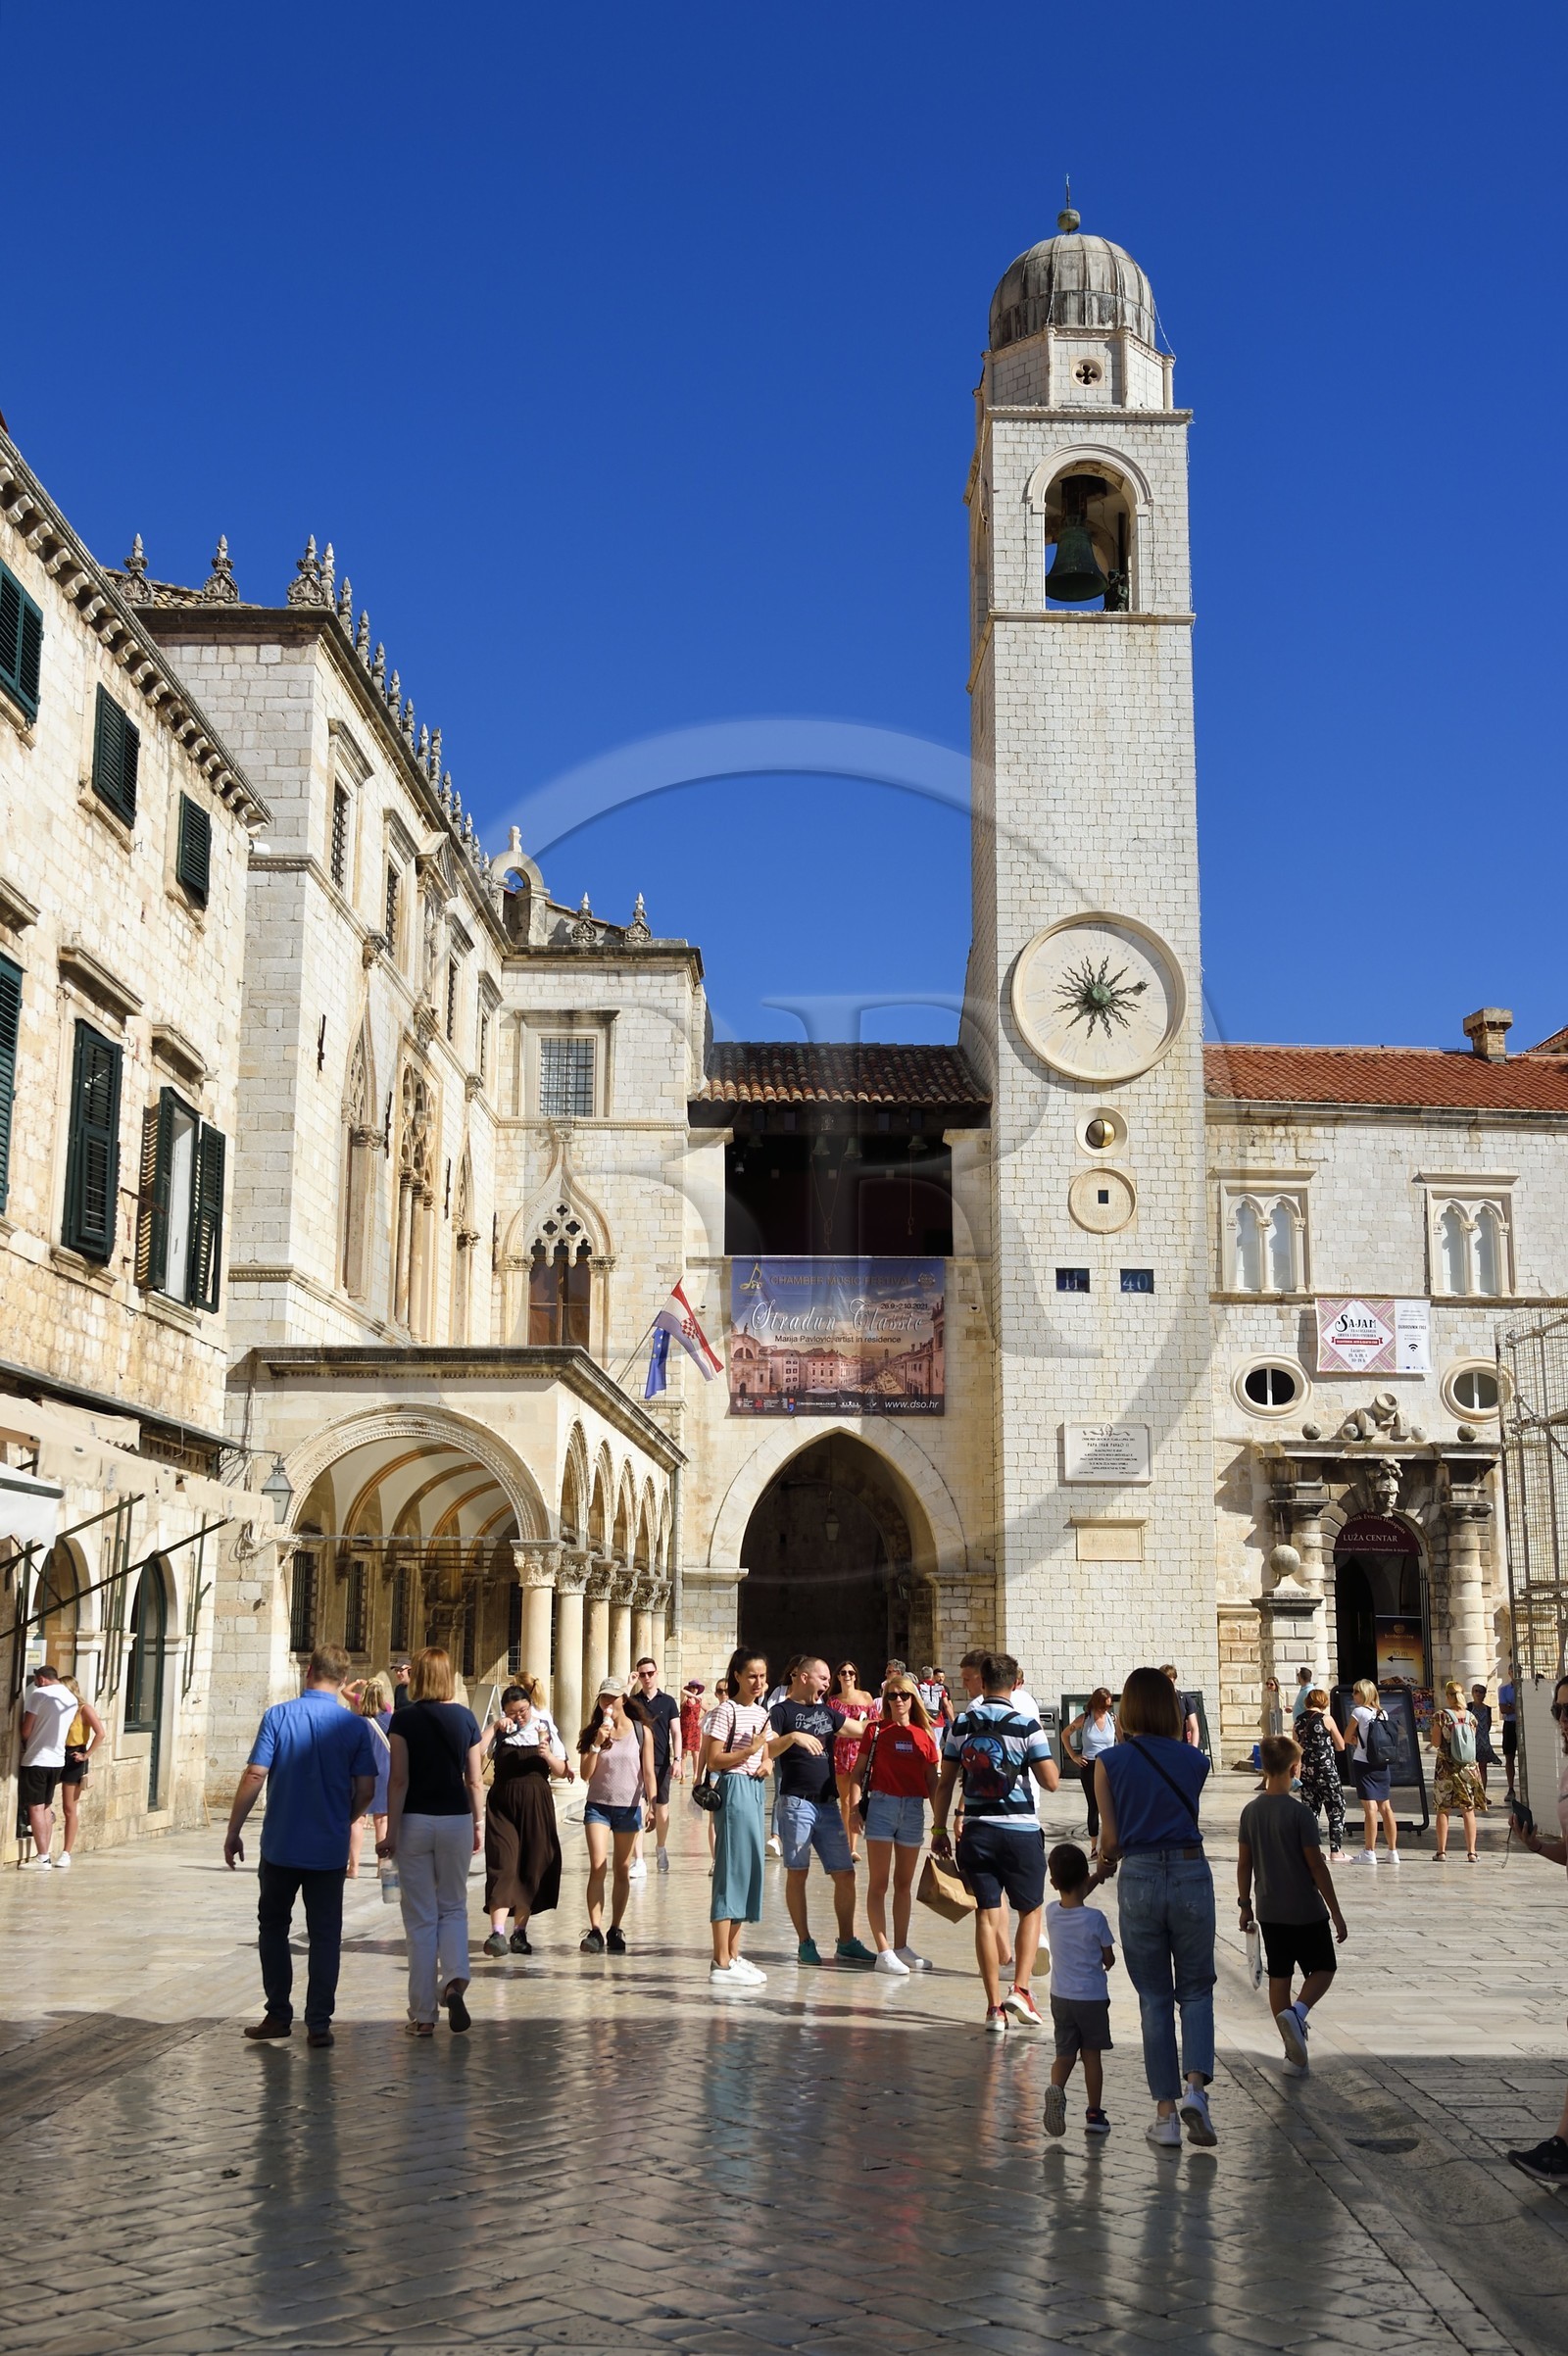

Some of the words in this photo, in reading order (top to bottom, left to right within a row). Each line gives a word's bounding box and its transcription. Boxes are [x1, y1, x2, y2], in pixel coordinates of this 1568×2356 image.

[770, 1276, 823, 1286] CHAMBER
[827, 1276, 861, 1286] MUSIC
[864, 1276, 910, 1286] FESTIVAL
[1122, 1272, 1150, 1292] 40
[751, 1299, 836, 1331] Stradun
[848, 1298, 923, 1332] Classic
[774, 1335, 798, 1344] Marija
[835, 1335, 854, 1344] artist
[864, 1335, 902, 1344] residence
[884, 1399, 940, 1409] www.dso.hr
[1343, 1533, 1364, 1542] LUŽA
[1365, 1534, 1398, 1543] CENTAR
